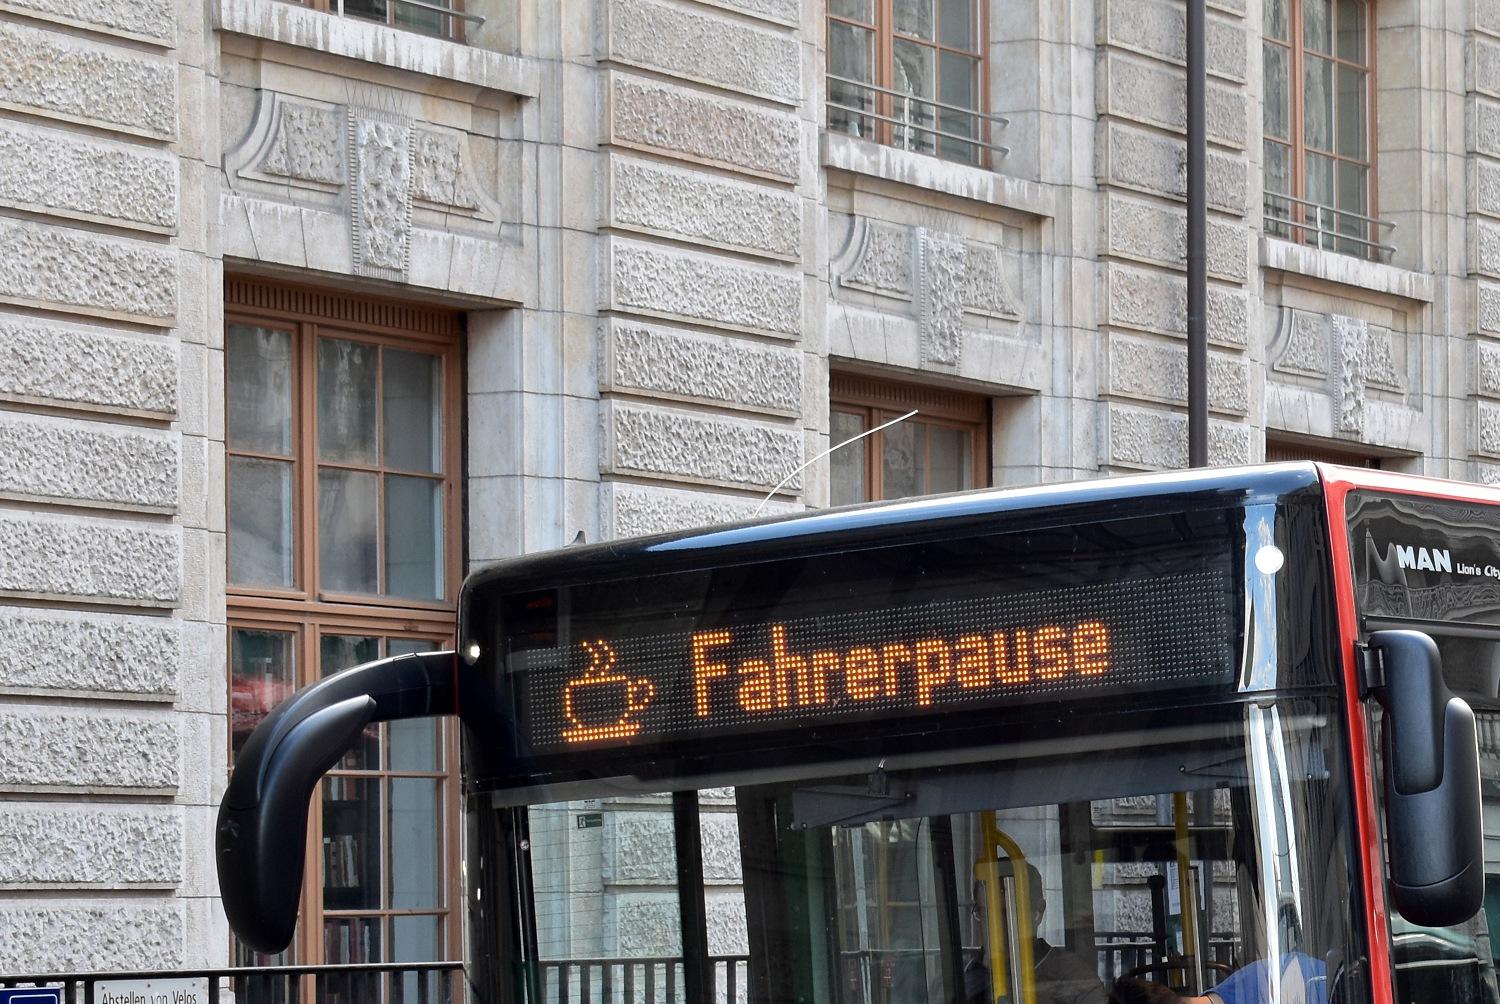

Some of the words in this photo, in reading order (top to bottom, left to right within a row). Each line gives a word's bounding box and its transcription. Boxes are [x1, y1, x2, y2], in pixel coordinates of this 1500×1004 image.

[1396, 545, 1452, 573] MAN
[1457, 563, 1481, 576] Lion's
[692, 622, 1110, 717] Fahrerpause
